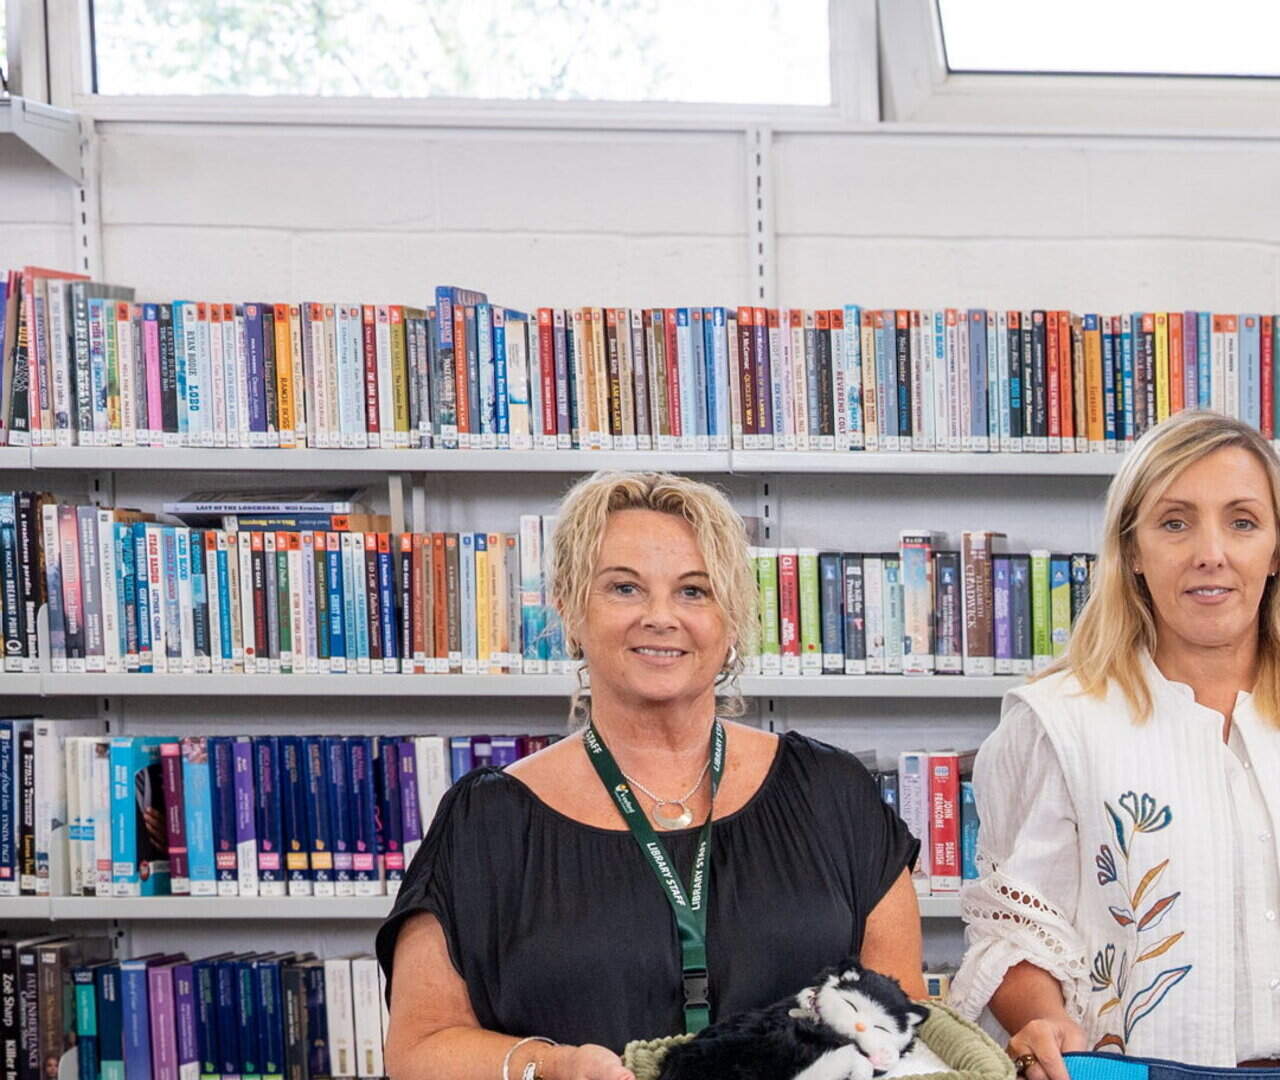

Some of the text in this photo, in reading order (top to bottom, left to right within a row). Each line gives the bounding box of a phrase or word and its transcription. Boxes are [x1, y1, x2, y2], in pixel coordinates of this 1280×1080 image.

[189, 385, 199, 411] LOBO
[280, 377, 288, 406] RANGE
[836, 371, 846, 434] REVEREND COLT
[745, 409, 753, 426] WAY
[21, 521, 29, 563] treacherous
[23, 565, 31, 596] paradise
[149, 534, 161, 641] STAGE RAIDER LUTHER CHANCE
[966, 564, 976, 629] CHADWICK
[6, 580, 18, 637] BREAKING POINT
[2, 757, 10, 774] Time
[713, 739, 722, 772] LIBRARY
[934, 792, 944, 829] FRANCOME
[2, 844, 10, 863] PAGE
[935, 843, 944, 866] FINISH
[946, 842, 954, 866] DEADLY
[647, 842, 686, 907] LIBRARY STAFF
[691, 869, 705, 911] LIBRARY
[3, 973, 18, 1069] Zoë Sharp Killer
[20, 991, 29, 1027] Catherine
[27, 973, 38, 1069] FATAL INHERITANCE
